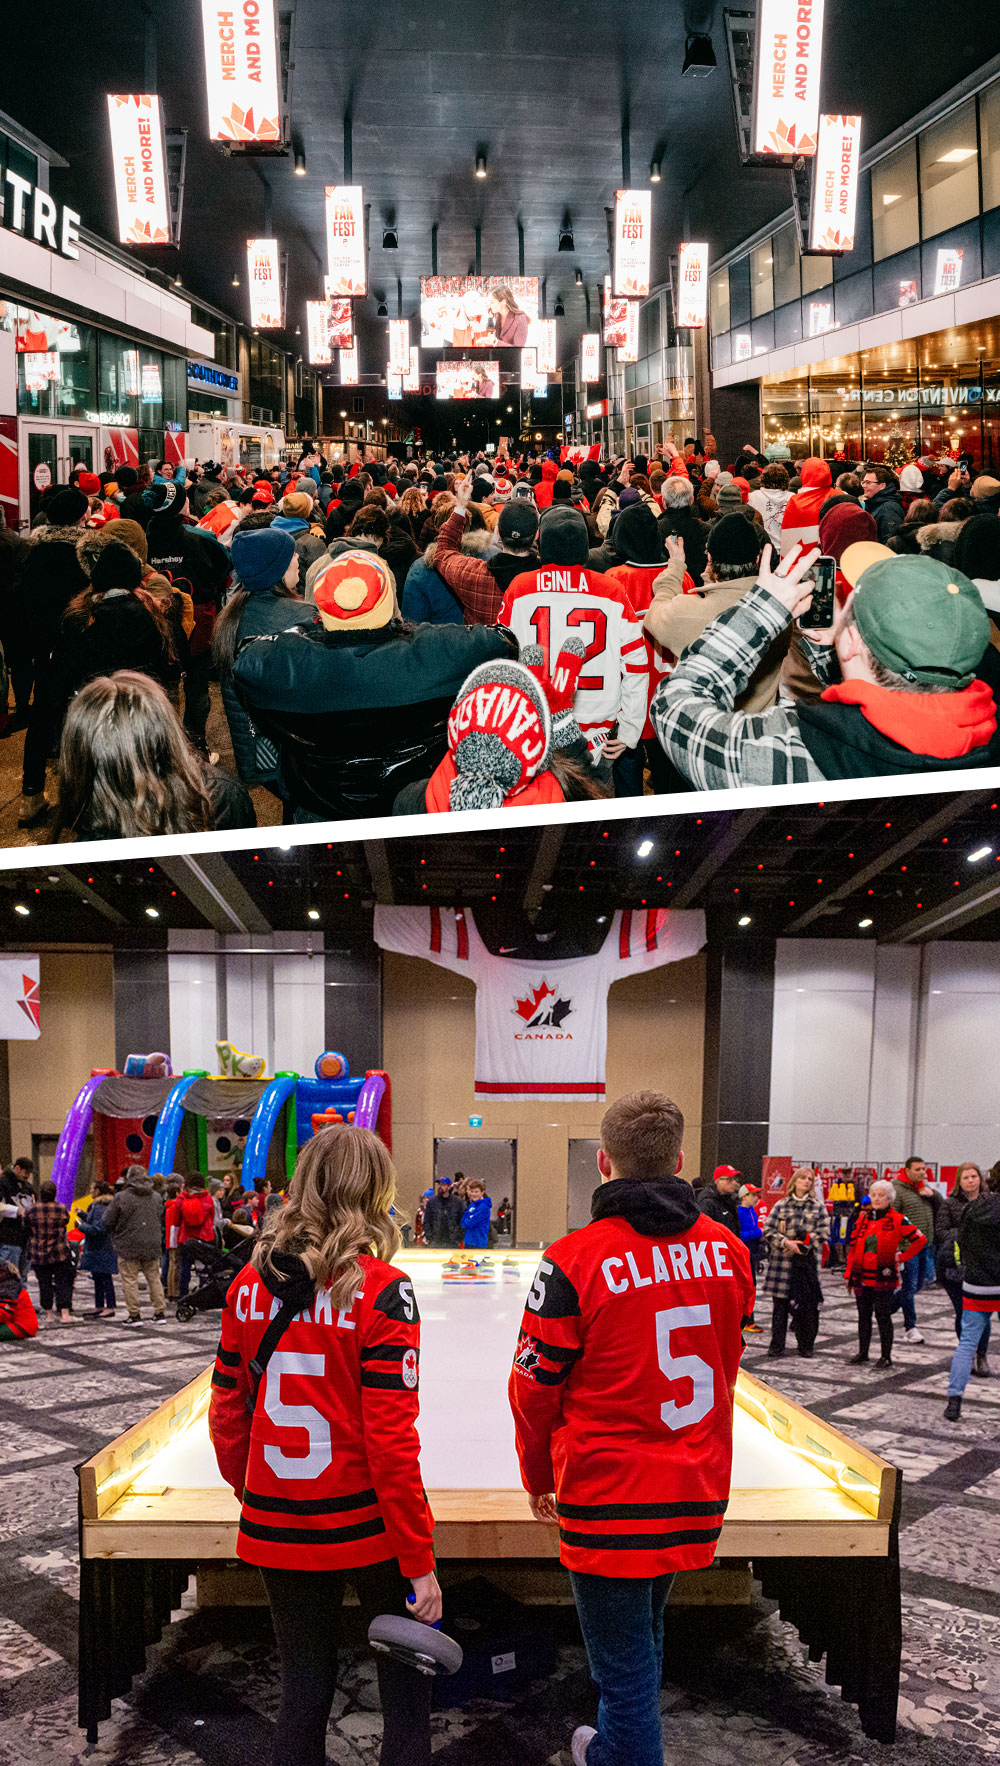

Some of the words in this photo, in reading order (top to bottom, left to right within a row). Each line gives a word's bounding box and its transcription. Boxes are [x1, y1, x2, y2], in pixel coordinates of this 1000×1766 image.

[217, 11, 236, 80] MERCH
[246, 42, 261, 83] AND
[772, 33, 787, 98] MERCH
[795, 63, 808, 101] AND
[137, 117, 153, 173] MORE!
[840, 135, 853, 186] MORE!
[123, 156, 137, 203] MERCH
[143, 176, 155, 204] AND
[824, 170, 835, 213] MERCH
[334, 204, 354, 220] FAN
[624, 208, 642, 223] FAN
[839, 189, 848, 215] AND
[333, 222, 356, 237] FEST
[622, 224, 644, 239] FEST
[253, 268, 272, 280] FEST
[255, 255, 271, 267] FAN
[685, 270, 702, 282] FEST
[687, 258, 701, 269] FAN
[151, 555, 184, 564] Hershey
[536, 570, 589, 593] IGINLA
[529, 605, 607, 690] 12
[514, 1033, 573, 1041] CANADA
[217, 1045, 251, 1077] PK
[601, 1241, 734, 1294] CLARKE
[527, 1259, 554, 1312] 5
[655, 1303, 714, 1431] 5
[263, 1351, 333, 1479] 5
